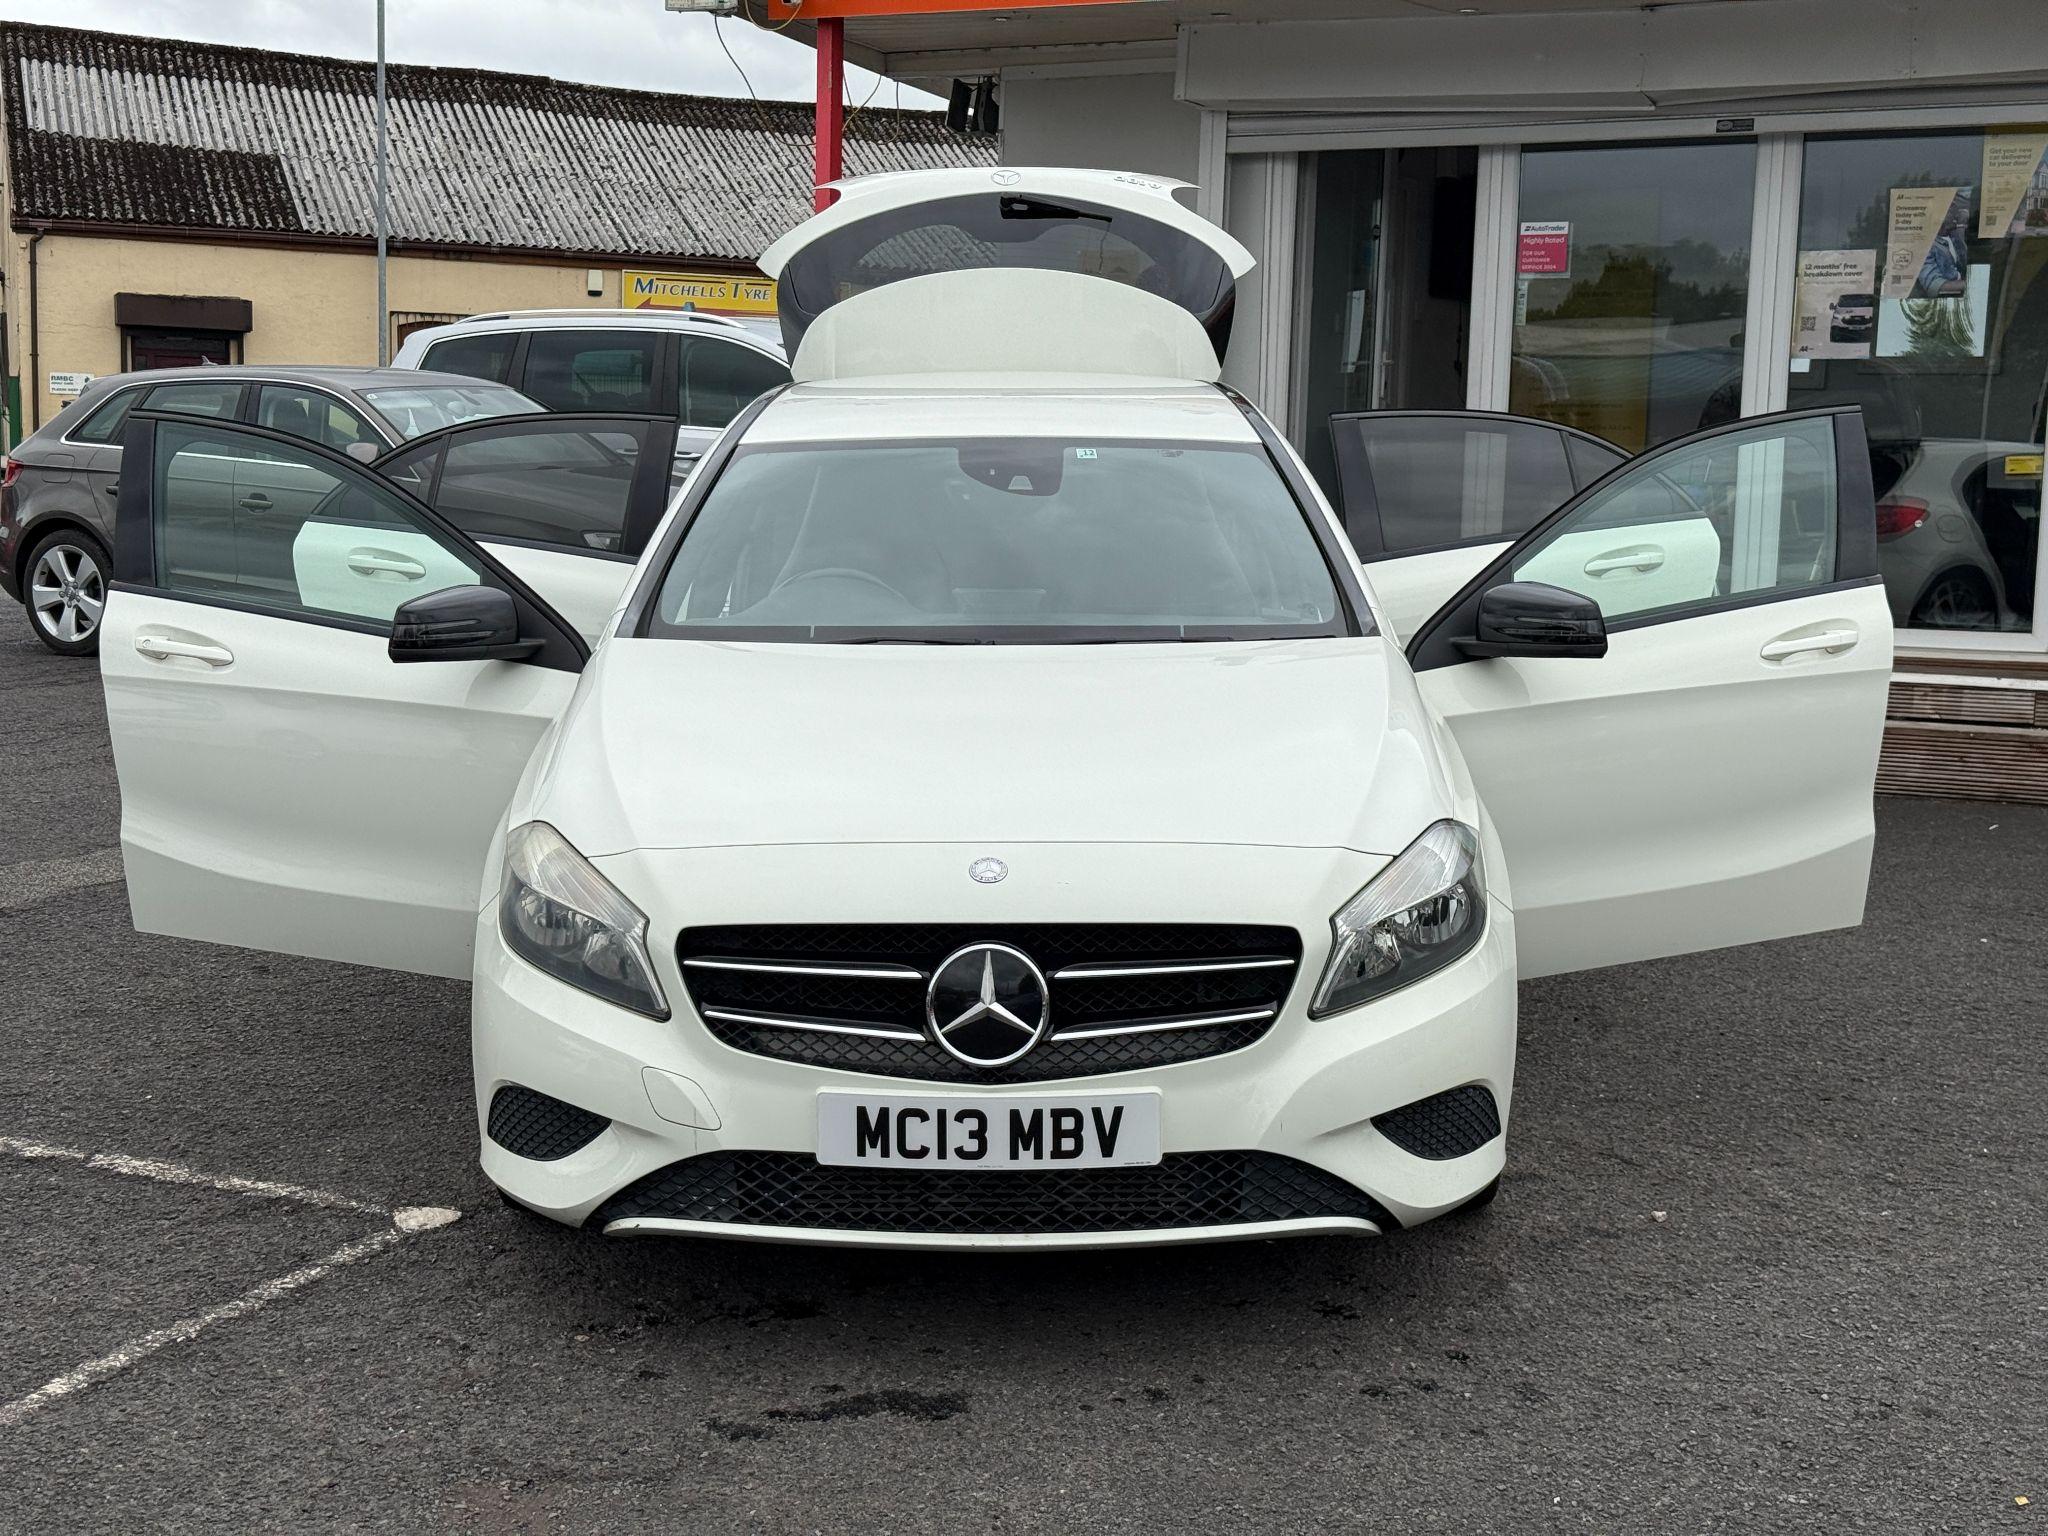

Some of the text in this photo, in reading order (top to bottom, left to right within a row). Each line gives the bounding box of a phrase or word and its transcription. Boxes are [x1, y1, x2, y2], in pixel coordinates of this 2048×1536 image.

[1523, 236, 1565, 245] Highly Rated
[1813, 262, 1842, 270] months'
[1843, 262, 1858, 271] free
[1803, 270, 1843, 278] breakdown
[634, 277, 771, 301] MITCHELLS TYRE
[856, 1105, 1125, 1161] MC13 MBV
